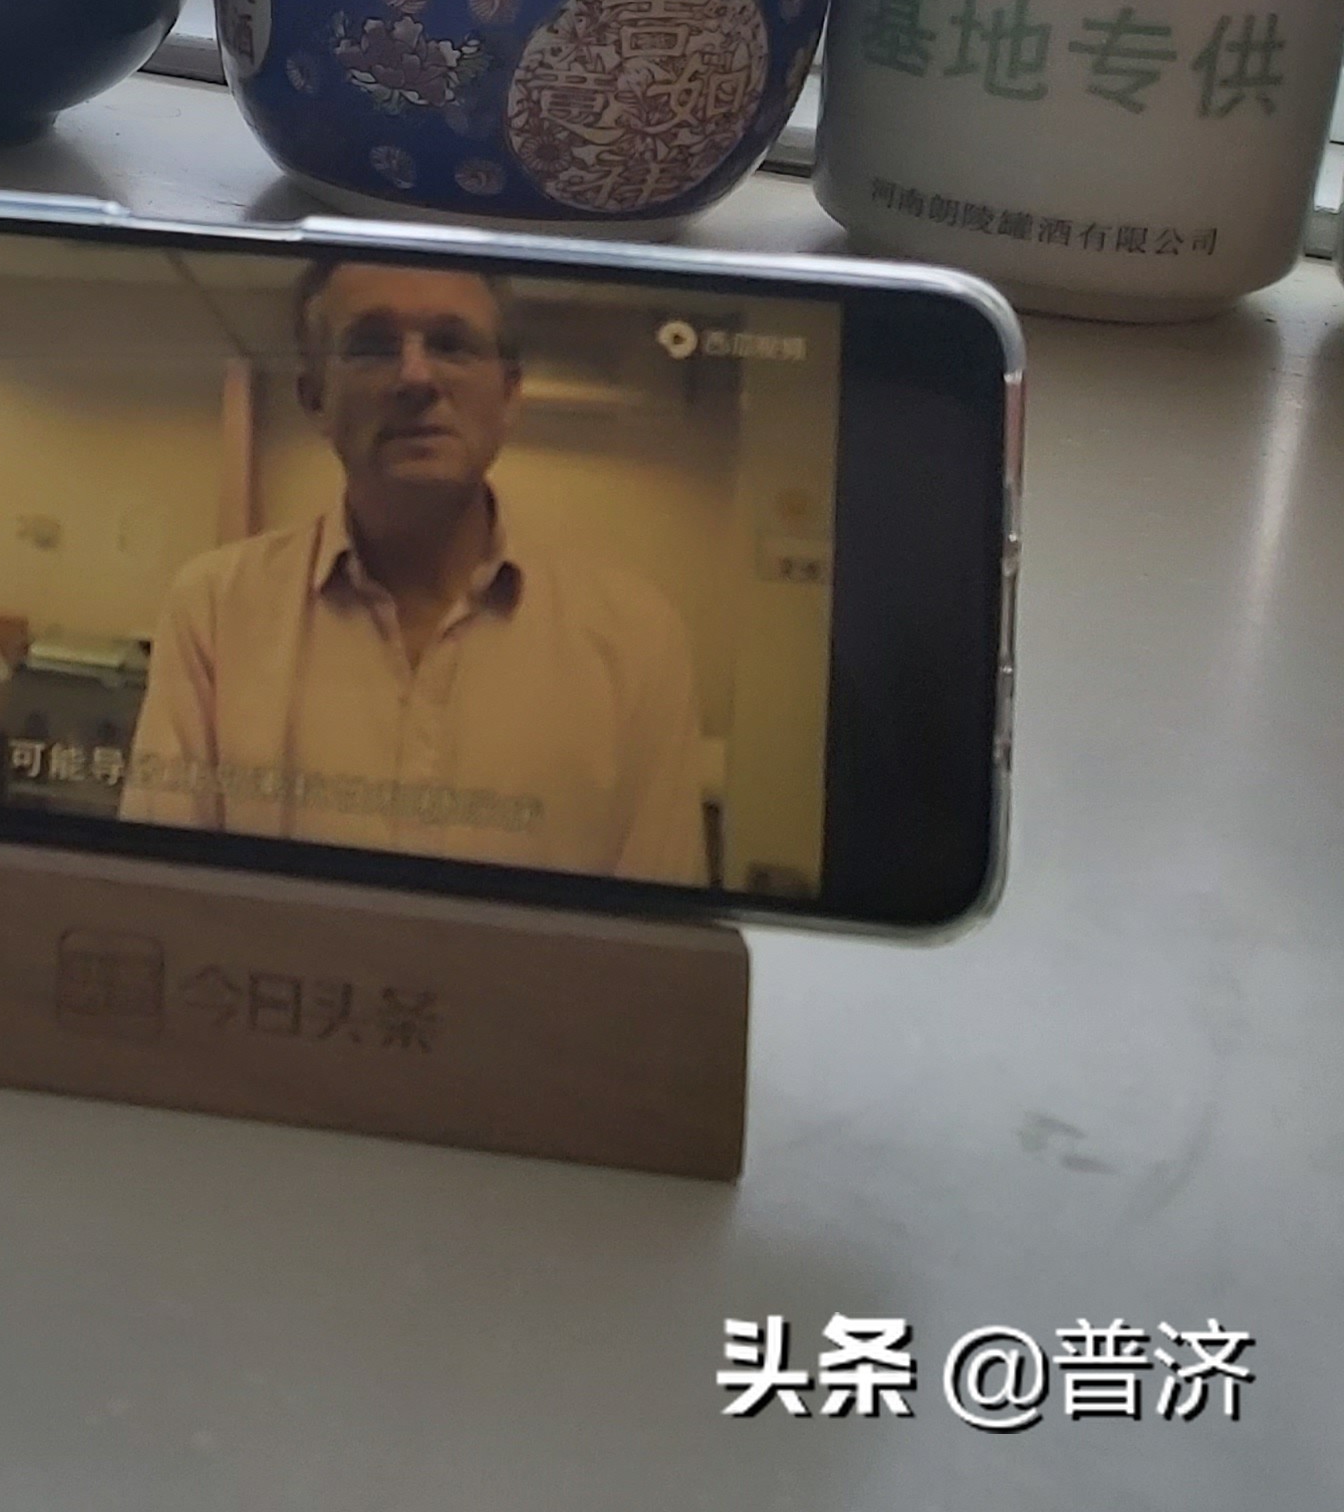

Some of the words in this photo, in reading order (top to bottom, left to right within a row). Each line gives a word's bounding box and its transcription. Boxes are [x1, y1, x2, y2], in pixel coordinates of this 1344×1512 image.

[870, 176, 1219, 257] 河南朗陵罐酒有限公司
[179, 962, 444, 1054] 今日头条
